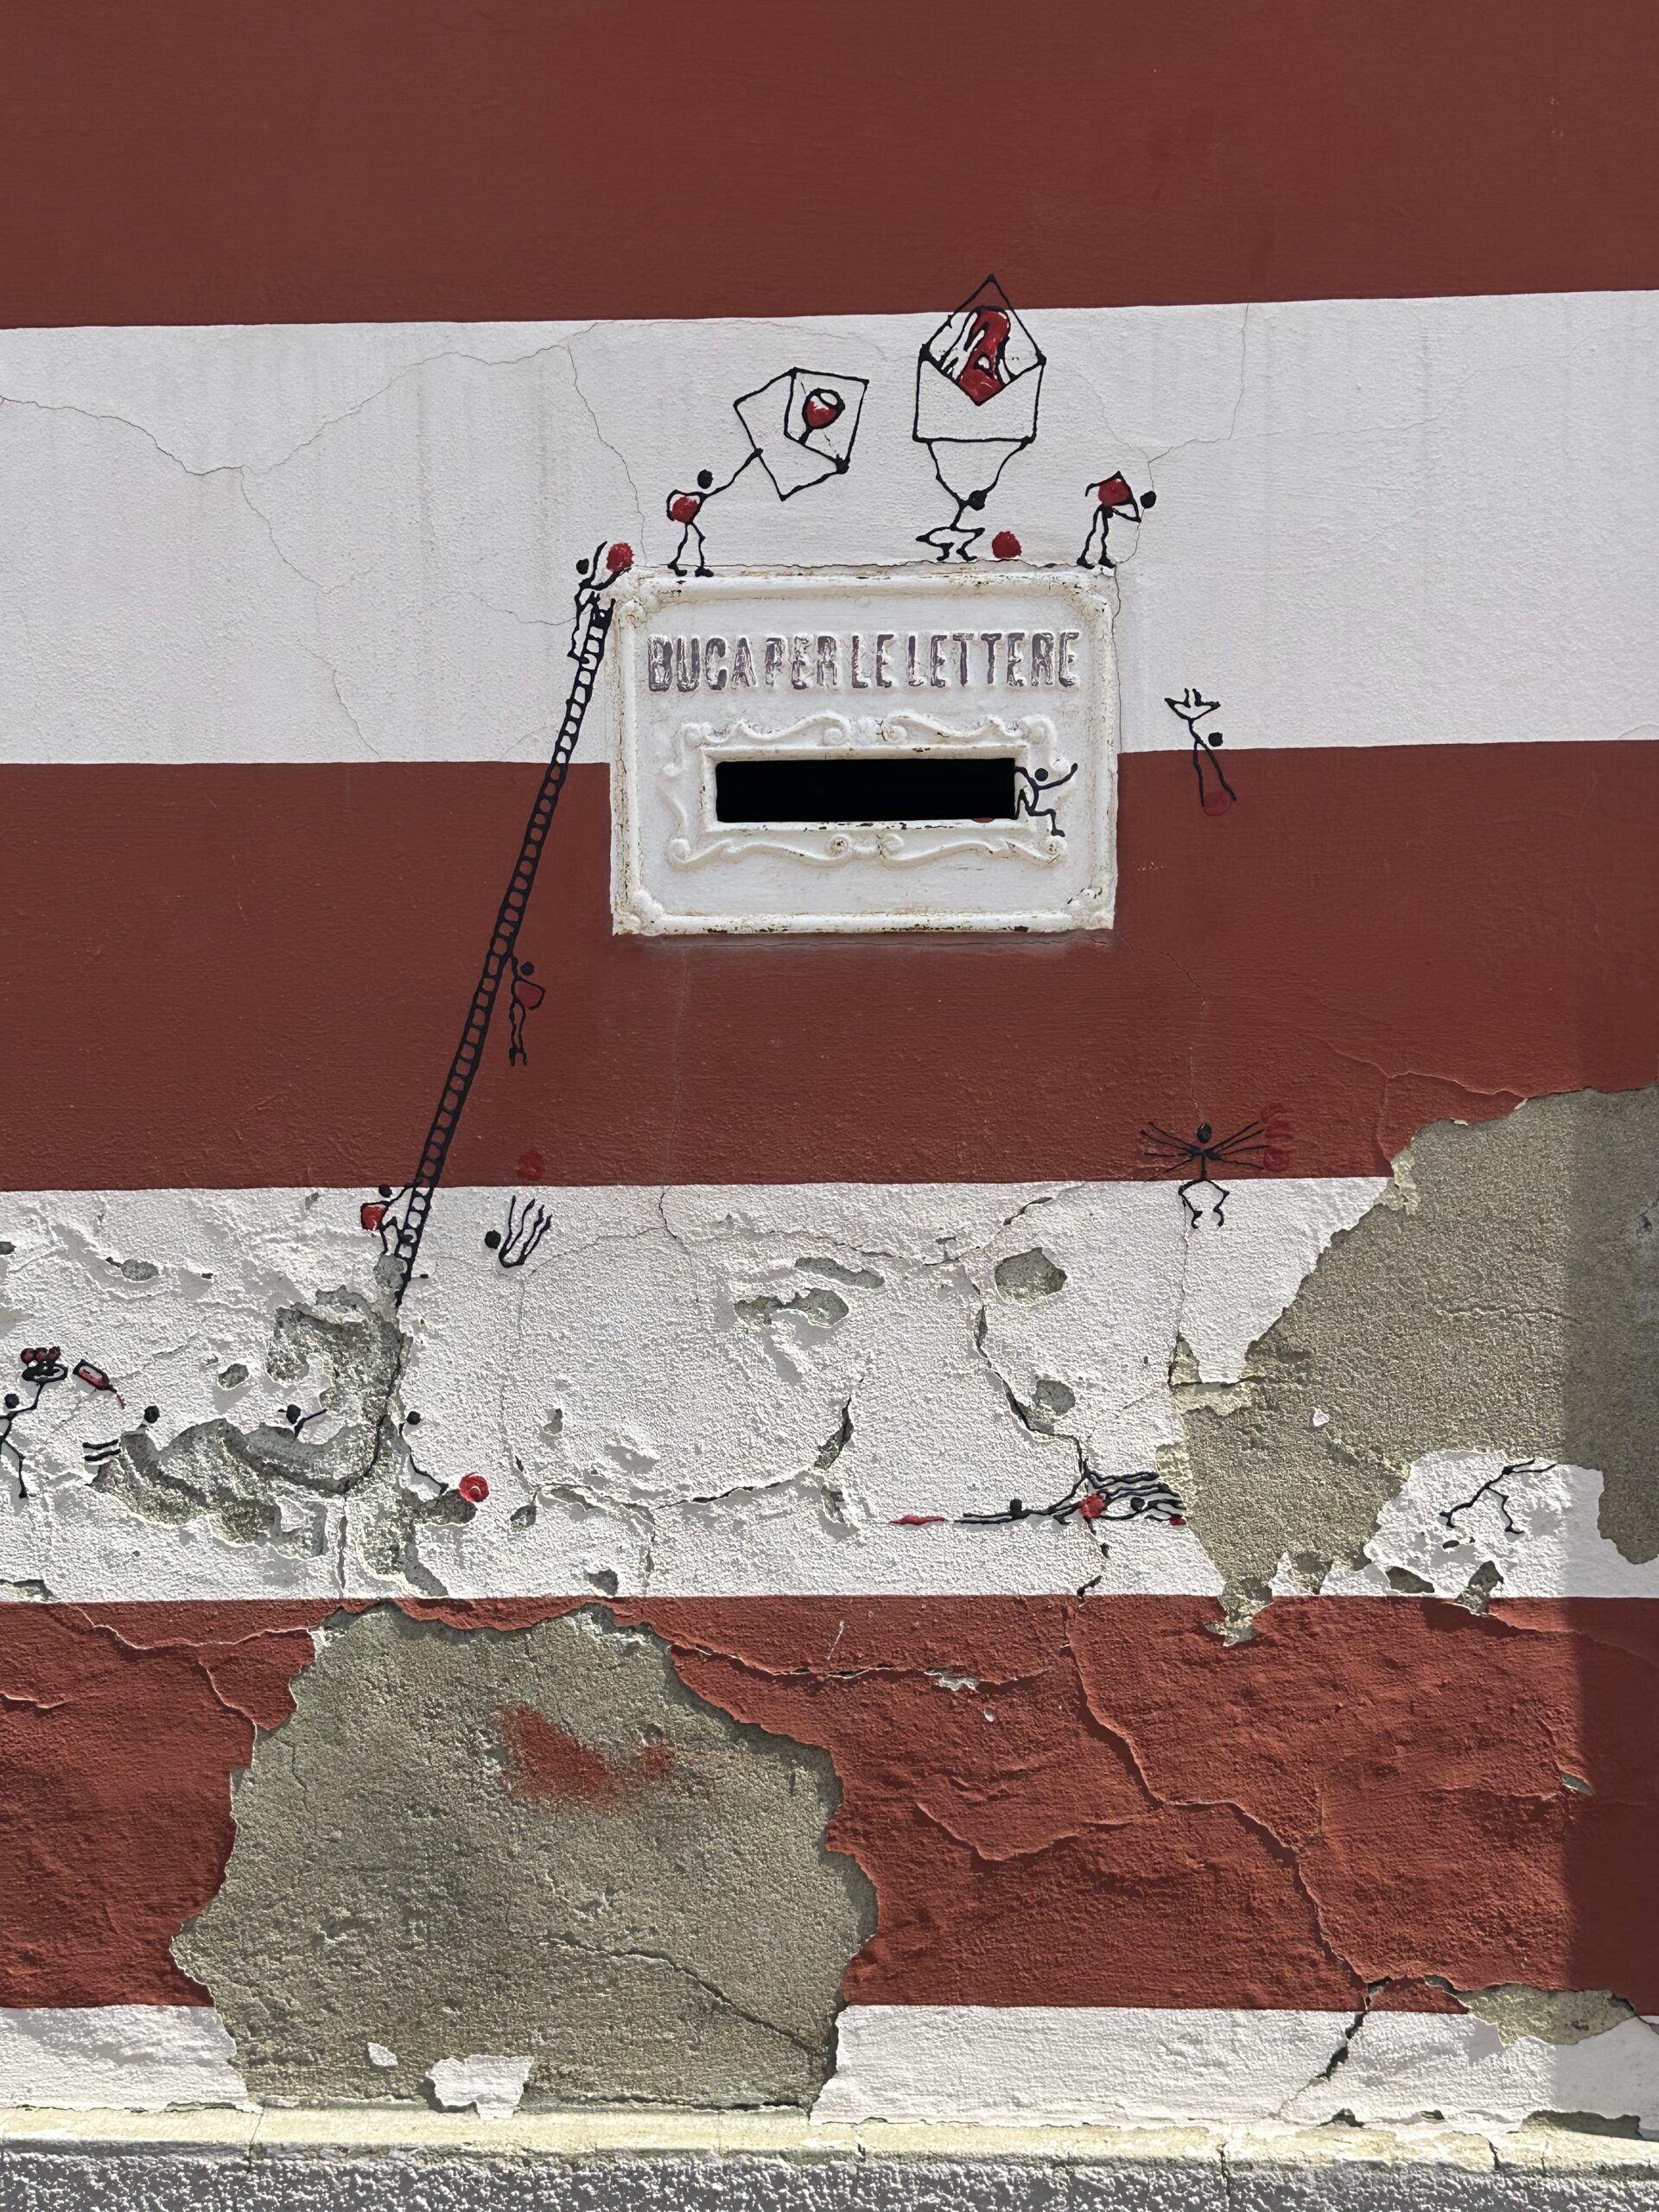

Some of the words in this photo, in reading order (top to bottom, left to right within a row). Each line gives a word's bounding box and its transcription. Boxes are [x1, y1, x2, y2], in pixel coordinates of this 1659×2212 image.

[647, 634, 757, 692] BUCA
[764, 635, 840, 690] PER
[851, 632, 895, 690] LE
[907, 632, 1080, 688] LETTERE
